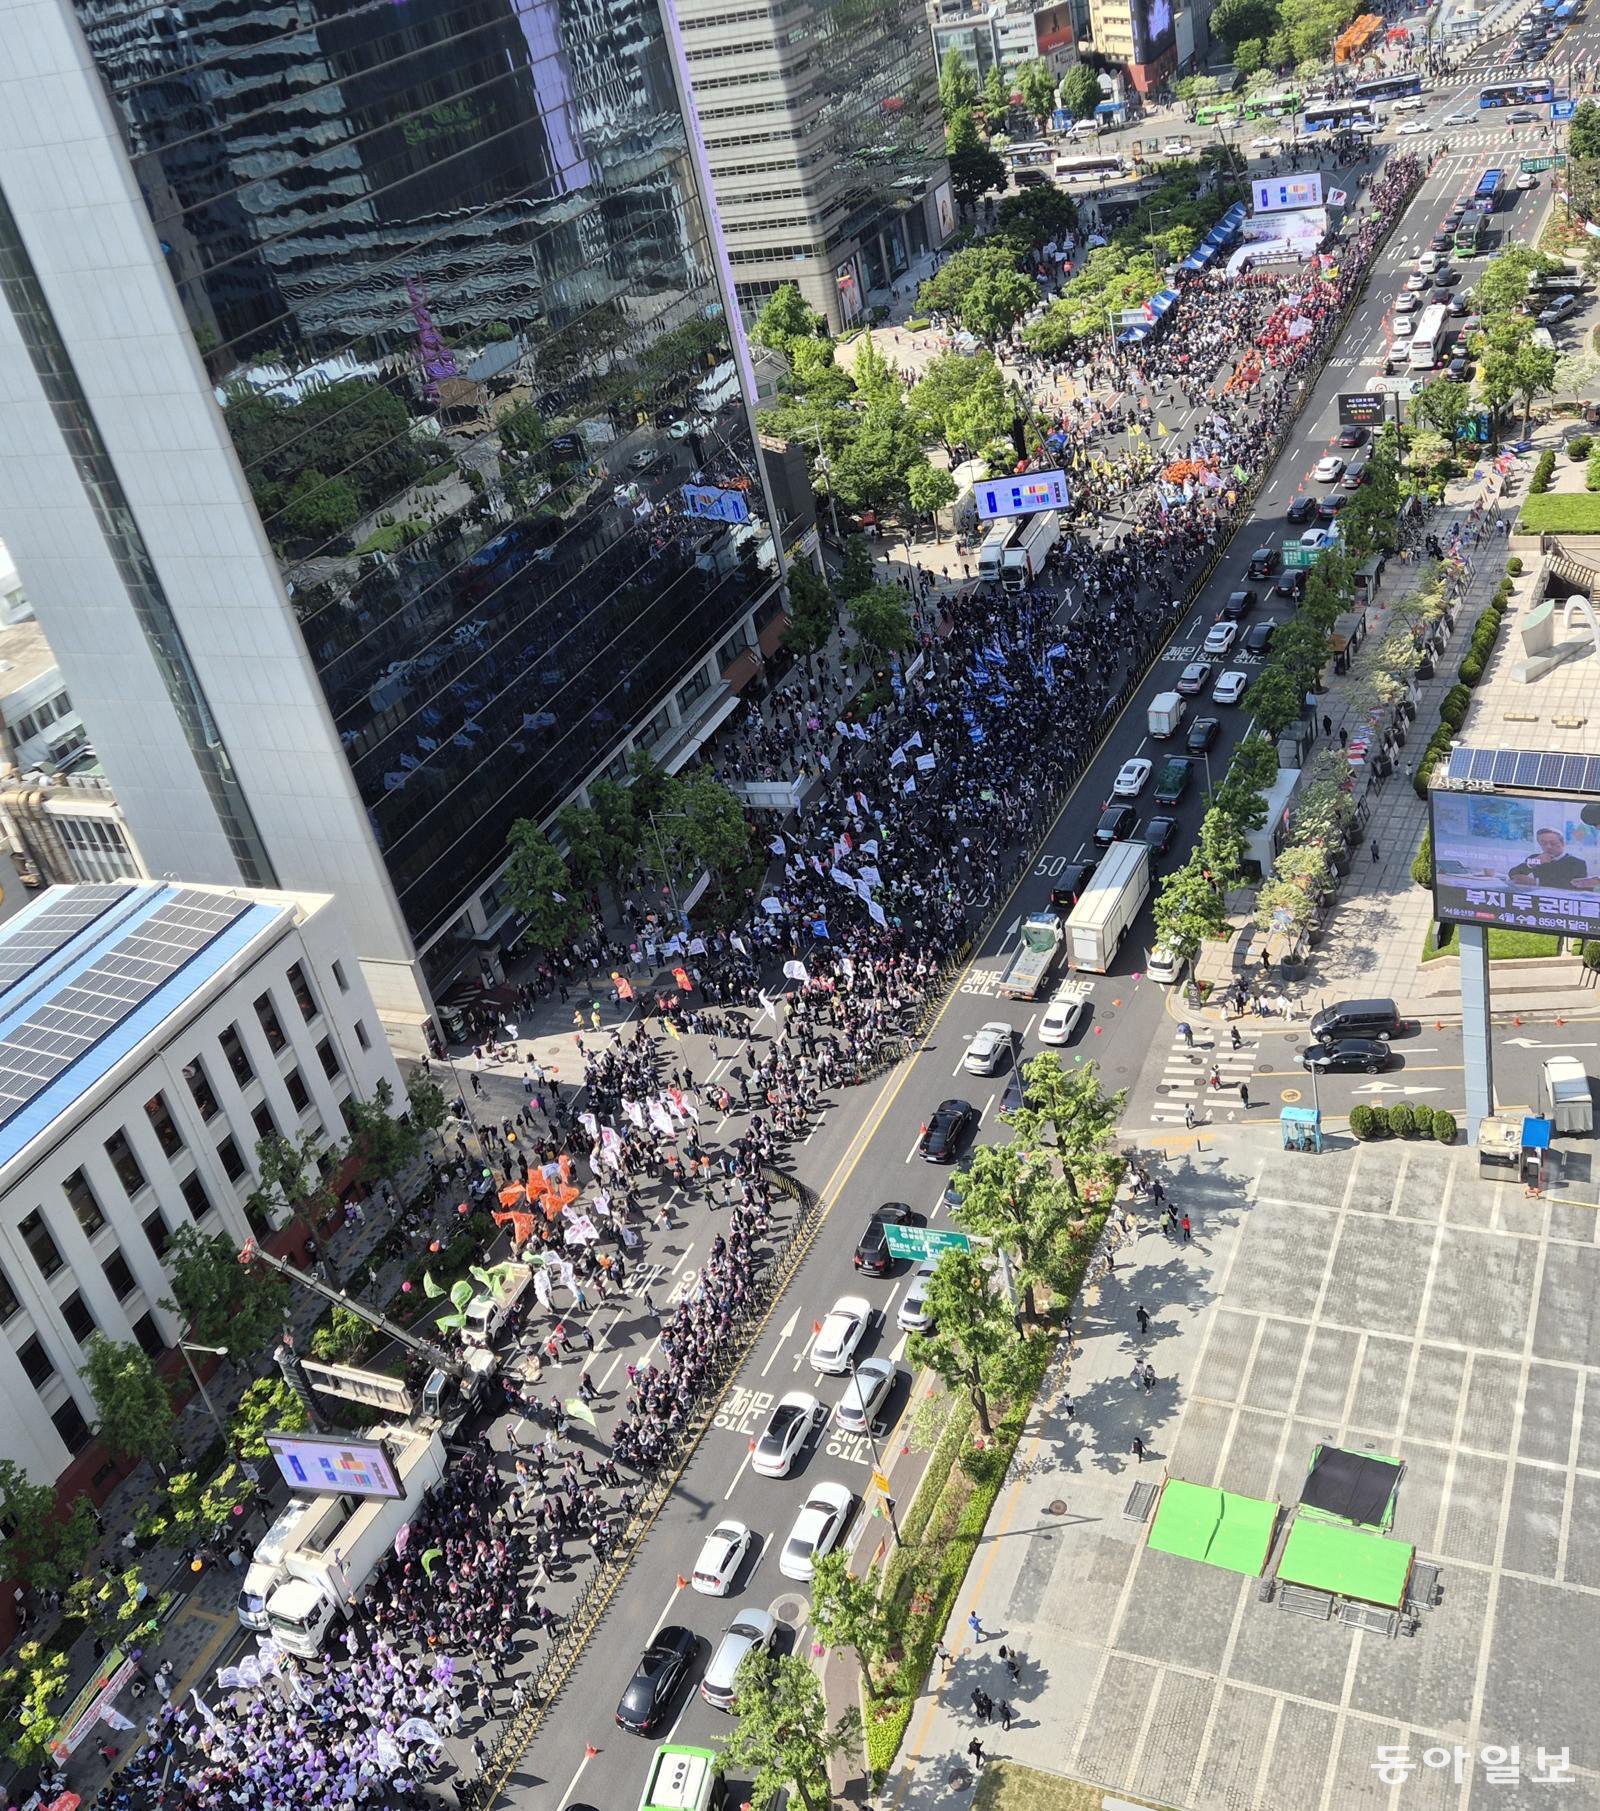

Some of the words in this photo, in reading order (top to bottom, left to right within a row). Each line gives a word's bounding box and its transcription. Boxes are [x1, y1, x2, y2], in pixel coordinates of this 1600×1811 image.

[1436, 777, 1495, 793] 서울신문
[1033, 855, 1067, 877] 50
[1466, 889, 1506, 908] 부지
[1512, 894, 1532, 910] 두
[713, 1385, 774, 1435] 광화문
